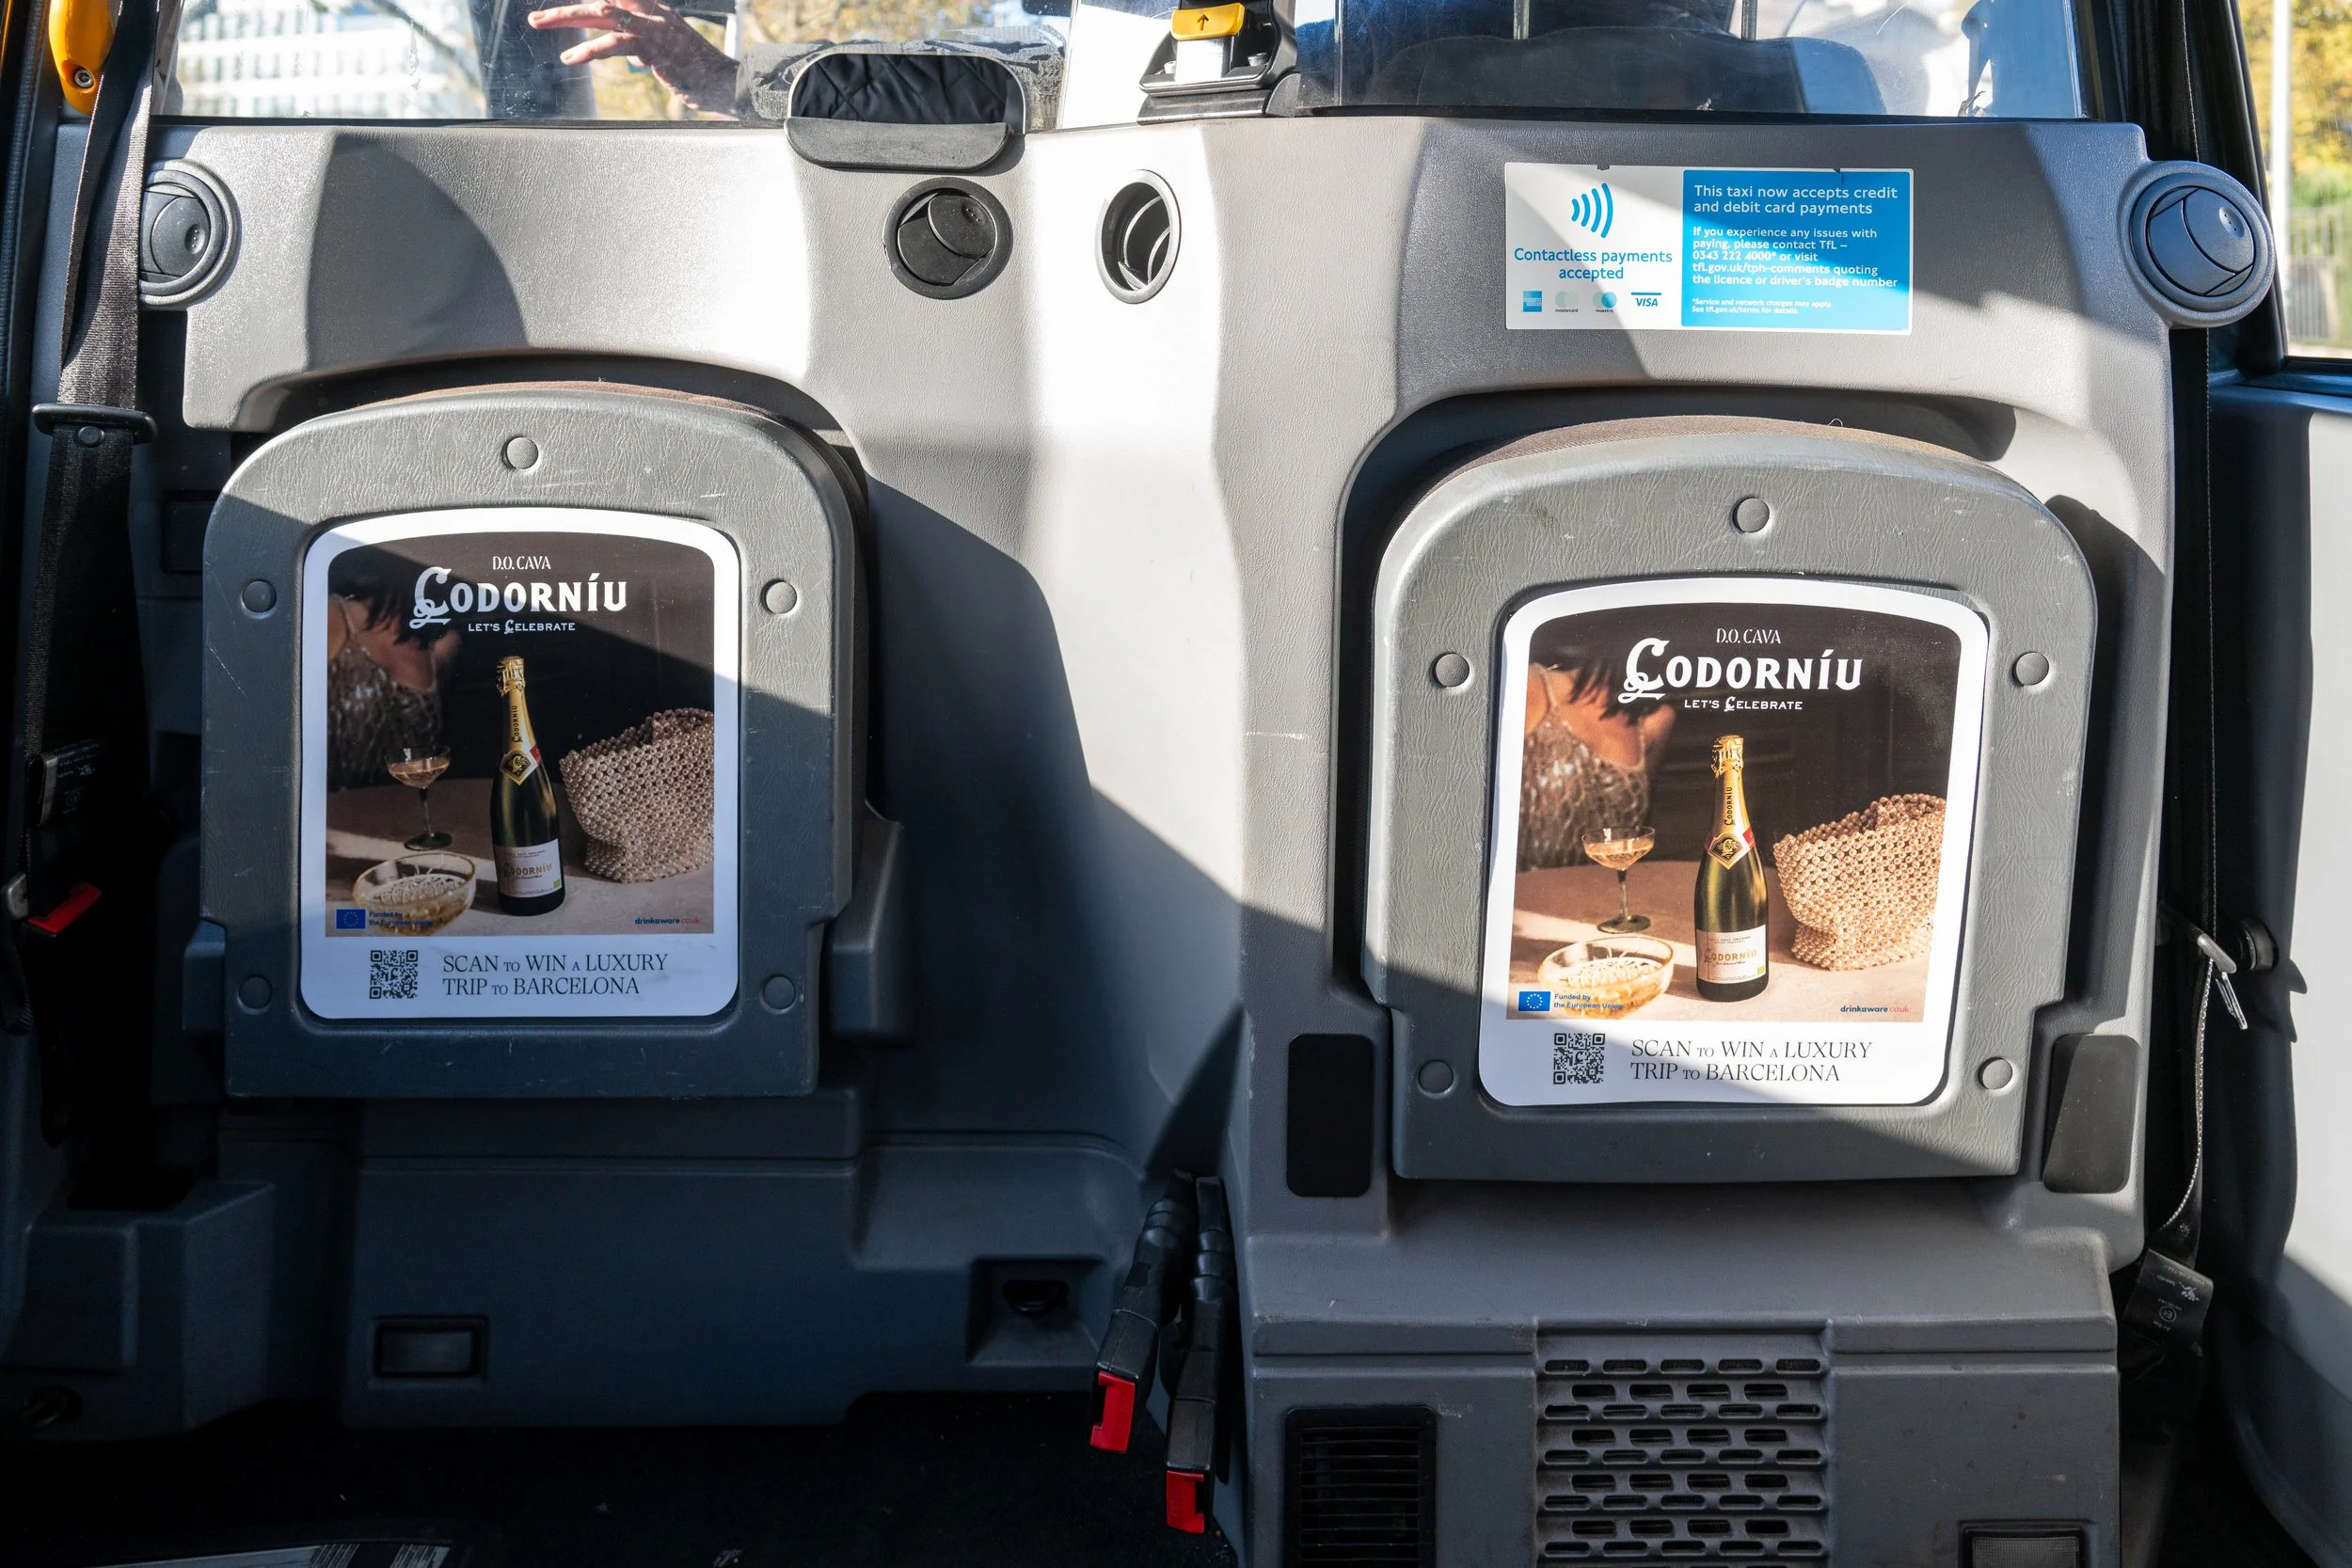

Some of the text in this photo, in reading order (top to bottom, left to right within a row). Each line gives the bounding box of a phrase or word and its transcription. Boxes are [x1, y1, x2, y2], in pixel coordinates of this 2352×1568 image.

[1694, 184, 1898, 201] This taxi now accepts credit
[1693, 201, 1873, 216] and debit card payments
[1693, 227, 1877, 239] If you experience any issues with
[1734, 239, 1770, 250] please
[1772, 240, 1816, 249] contact
[1820, 240, 1836, 249] TfL
[1514, 247, 1673, 264] Contactless payments
[1692, 251, 1719, 261] 0343
[1722, 251, 1741, 261] 222
[1779, 253, 1791, 261] or
[1794, 252, 1818, 261] visit
[1559, 267, 1624, 281] accepted
[1692, 263, 1878, 276] tfl.gov.uk/tph-comments quoting
[1692, 275, 1710, 284] the
[1714, 275, 1752, 284] licence
[1771, 276, 1811, 285] driver's
[1815, 277, 1850, 288] badge
[1852, 277, 1898, 287] number
[1635, 297, 1658, 307] VISA
[1766, 299, 1793, 308] charges
[492, 556, 551, 570] D.O. CAVA
[409, 566, 628, 629] CODORNÍU
[469, 619, 576, 635] LET'S CELEBRATE
[1716, 627, 1782, 644] D.O. CAVA
[1617, 637, 1863, 704] CODORNÍU
[1684, 696, 1803, 712] LET'S CELEBRATE
[443, 955, 499, 973] SCAN
[525, 955, 566, 972] WIN
[585, 954, 669, 972] LUXURY
[443, 978, 488, 995] TRIP
[514, 976, 640, 995] BARCELONA
[1582, 993, 1592, 1002] by
[1631, 1038, 1692, 1057] SCAN
[1721, 1040, 1764, 1058] WIN
[1785, 1041, 1872, 1058] LUXURY
[1630, 1062, 1678, 1080] TRIP
[1705, 1063, 1841, 1082] BARCELONA
